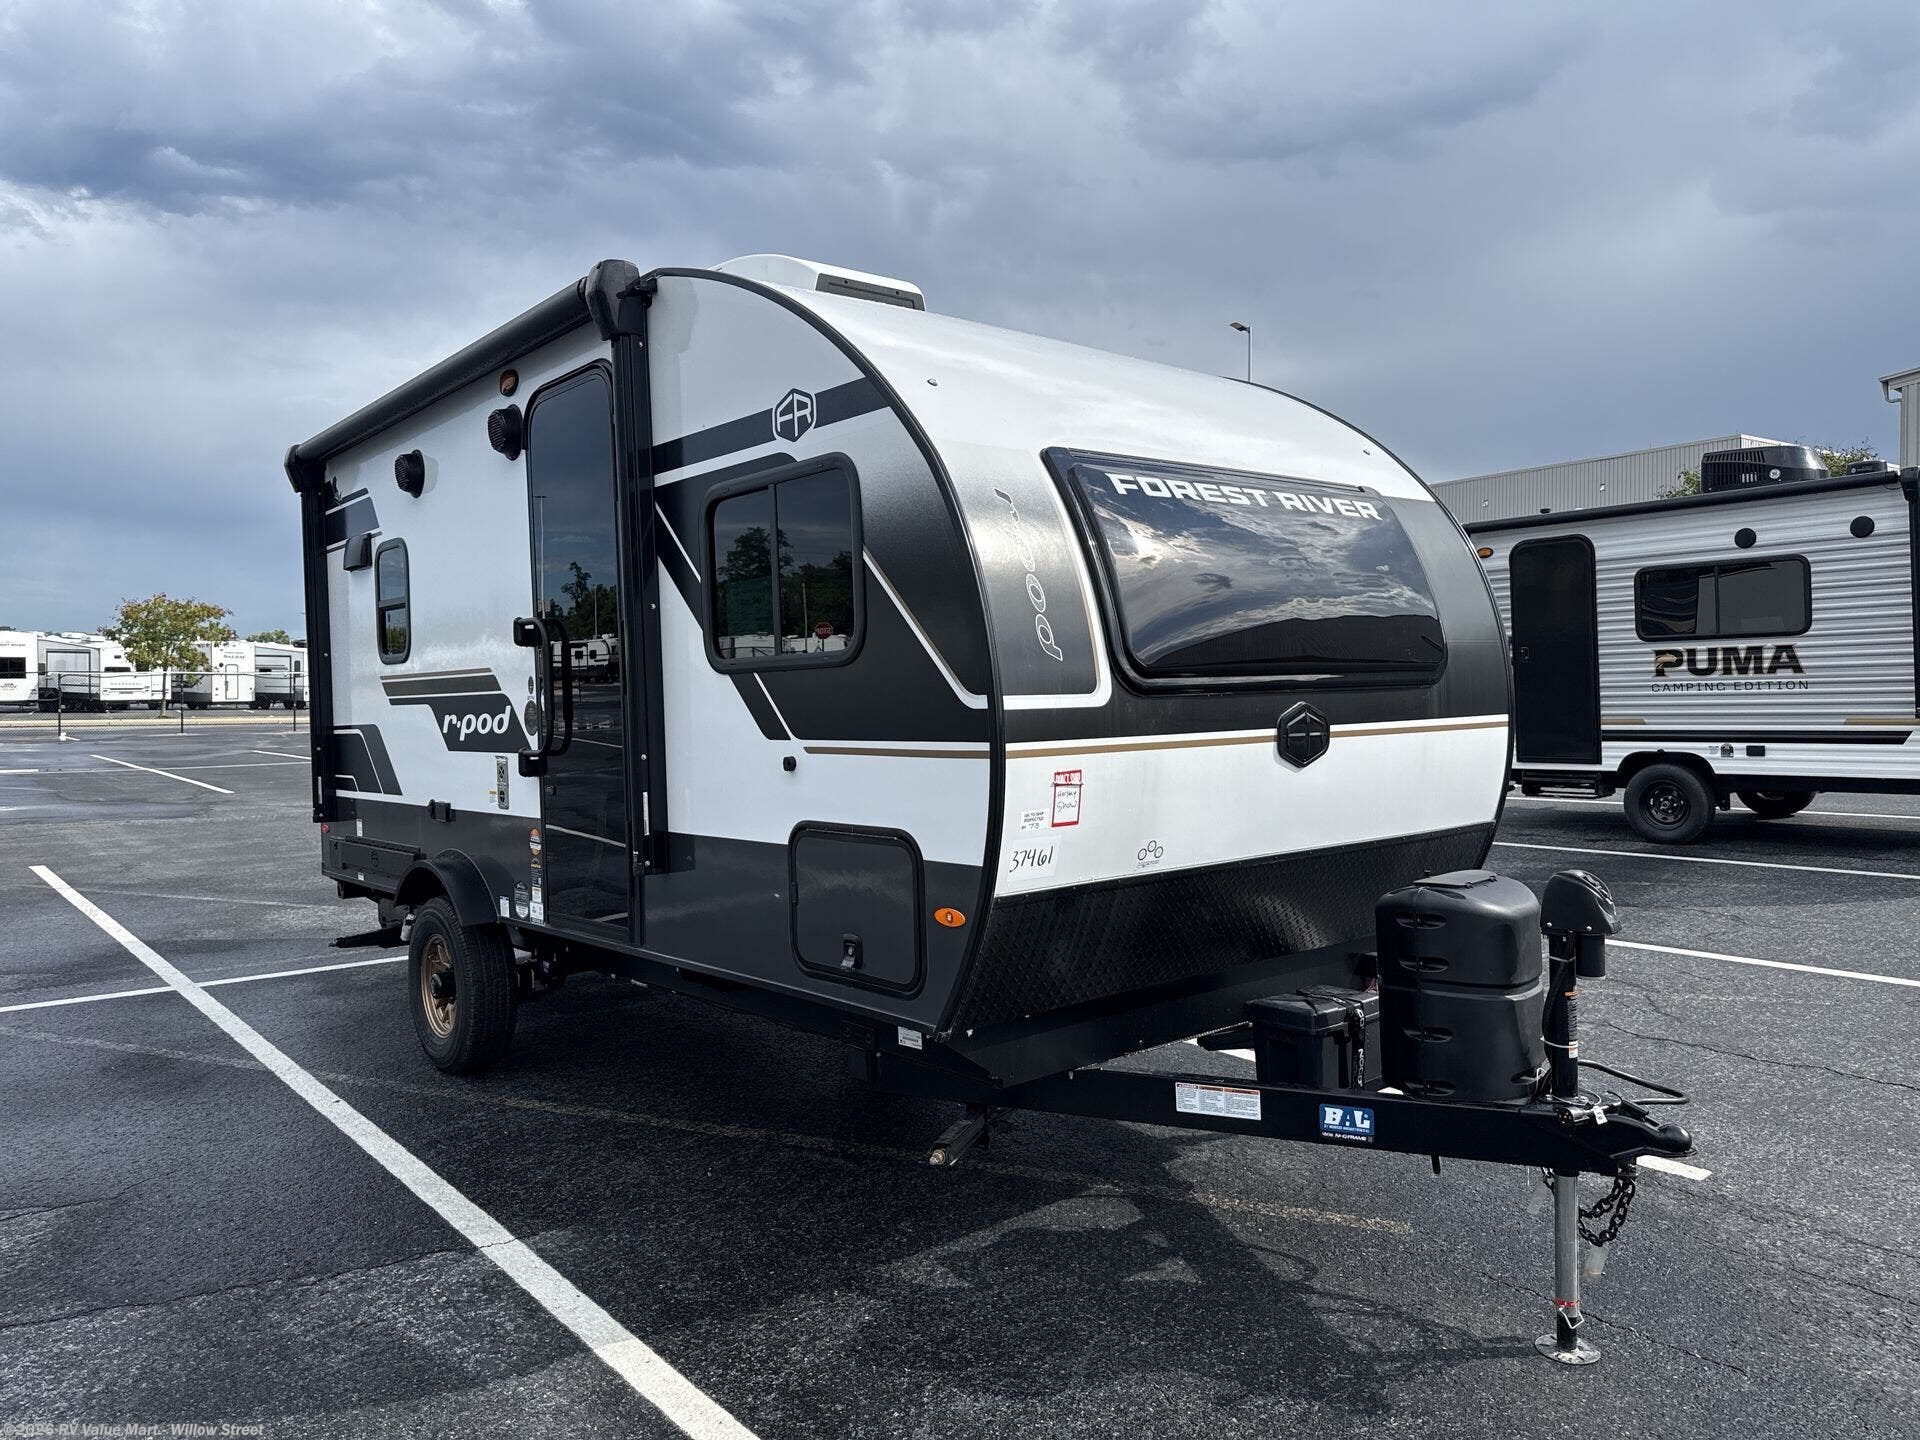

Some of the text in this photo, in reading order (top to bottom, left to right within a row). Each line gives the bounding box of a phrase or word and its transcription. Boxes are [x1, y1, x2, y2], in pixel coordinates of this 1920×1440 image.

[1104, 472, 1384, 521] FOREST RIVER
[1652, 645, 1806, 677] PUMA
[1651, 681, 1809, 692] CAMPING EDITION
[1009, 845, 1054, 873] 37461
[1324, 1107, 1371, 1129] BAL
